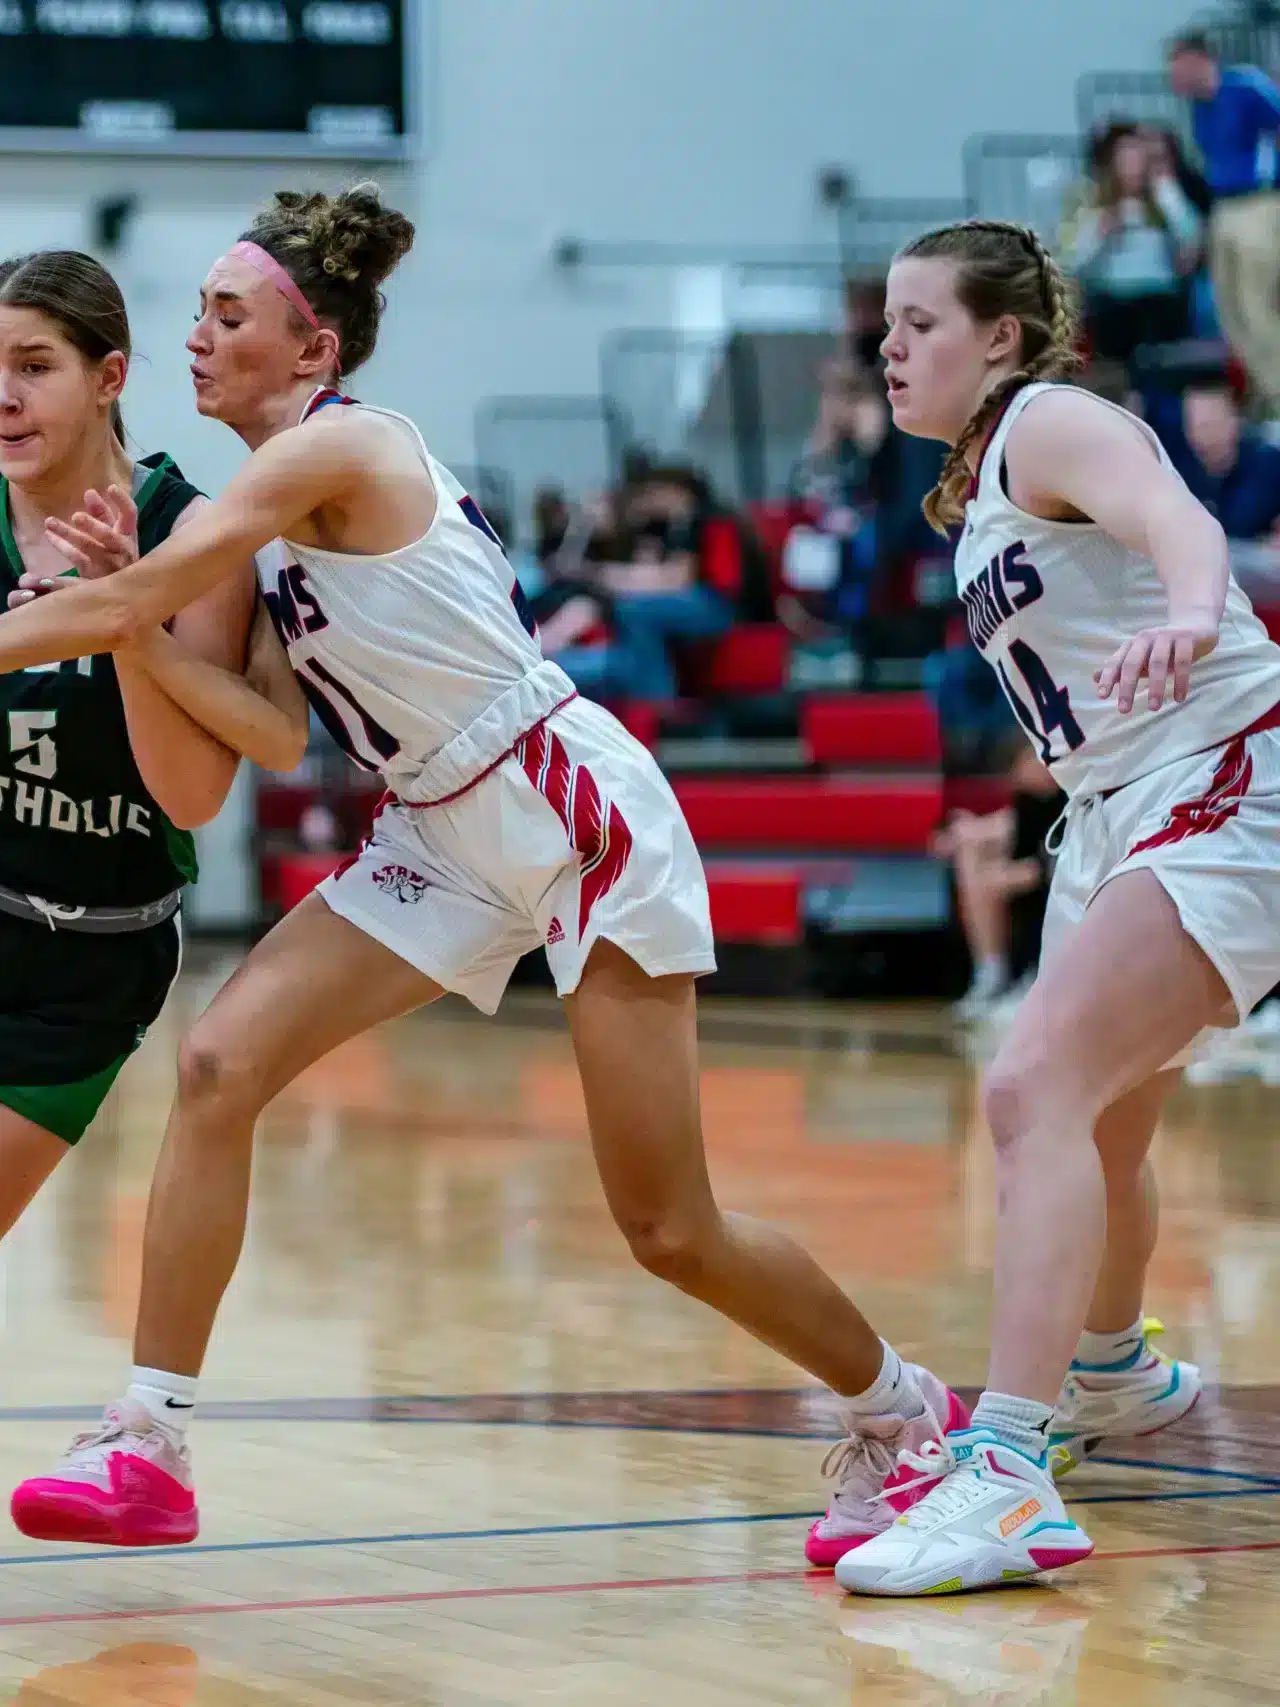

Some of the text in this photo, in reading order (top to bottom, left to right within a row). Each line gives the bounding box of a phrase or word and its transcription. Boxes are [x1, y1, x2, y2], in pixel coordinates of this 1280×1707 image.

[960, 539, 1045, 652] ORRIS
[6, 708, 58, 780] 5
[294, 655, 402, 774] 11
[996, 637, 1087, 767] 14
